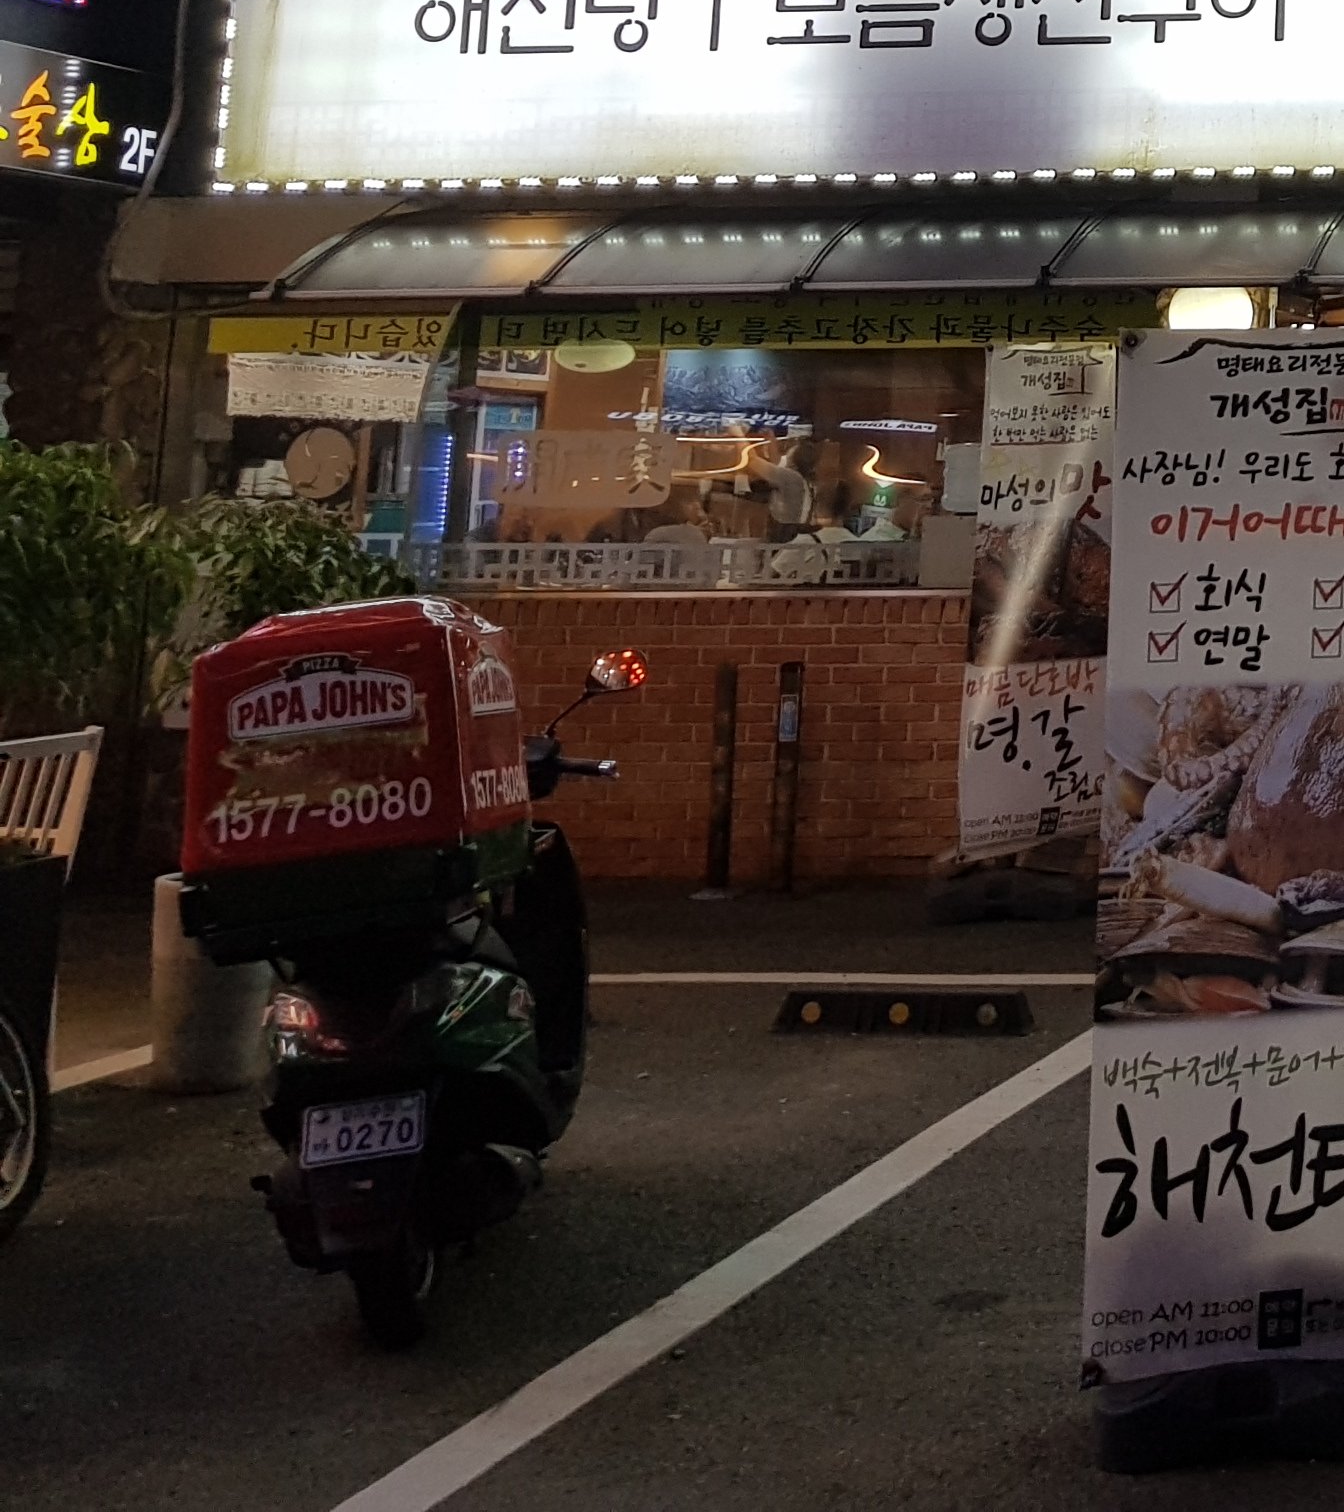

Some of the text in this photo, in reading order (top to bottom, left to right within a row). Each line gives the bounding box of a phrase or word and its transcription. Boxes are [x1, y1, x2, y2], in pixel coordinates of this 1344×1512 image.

[0, 69, 157, 174] 술상 2F
[1021, 372, 1066, 390] 개성집
[1210, 387, 1329, 425] 개성집
[1122, 448, 1227, 486] 사장님!
[1239, 450, 1315, 484] 우리도
[981, 474, 1055, 512] 마성의
[1194, 563, 1268, 612] 회식
[302, 657, 340, 673] PIZZA
[1194, 624, 1271, 672] 연말
[237, 679, 408, 731] PAPA JOHN'S
[1044, 770, 1094, 803] 조림
[211, 776, 433, 845] 1577-8080
[337, 1117, 415, 1153] 0270
[1150, 1300, 1194, 1323] AM
[1200, 1298, 1254, 1318] 11:00
[1149, 1329, 1188, 1352] PM
[1194, 1325, 1252, 1347] 10:00
